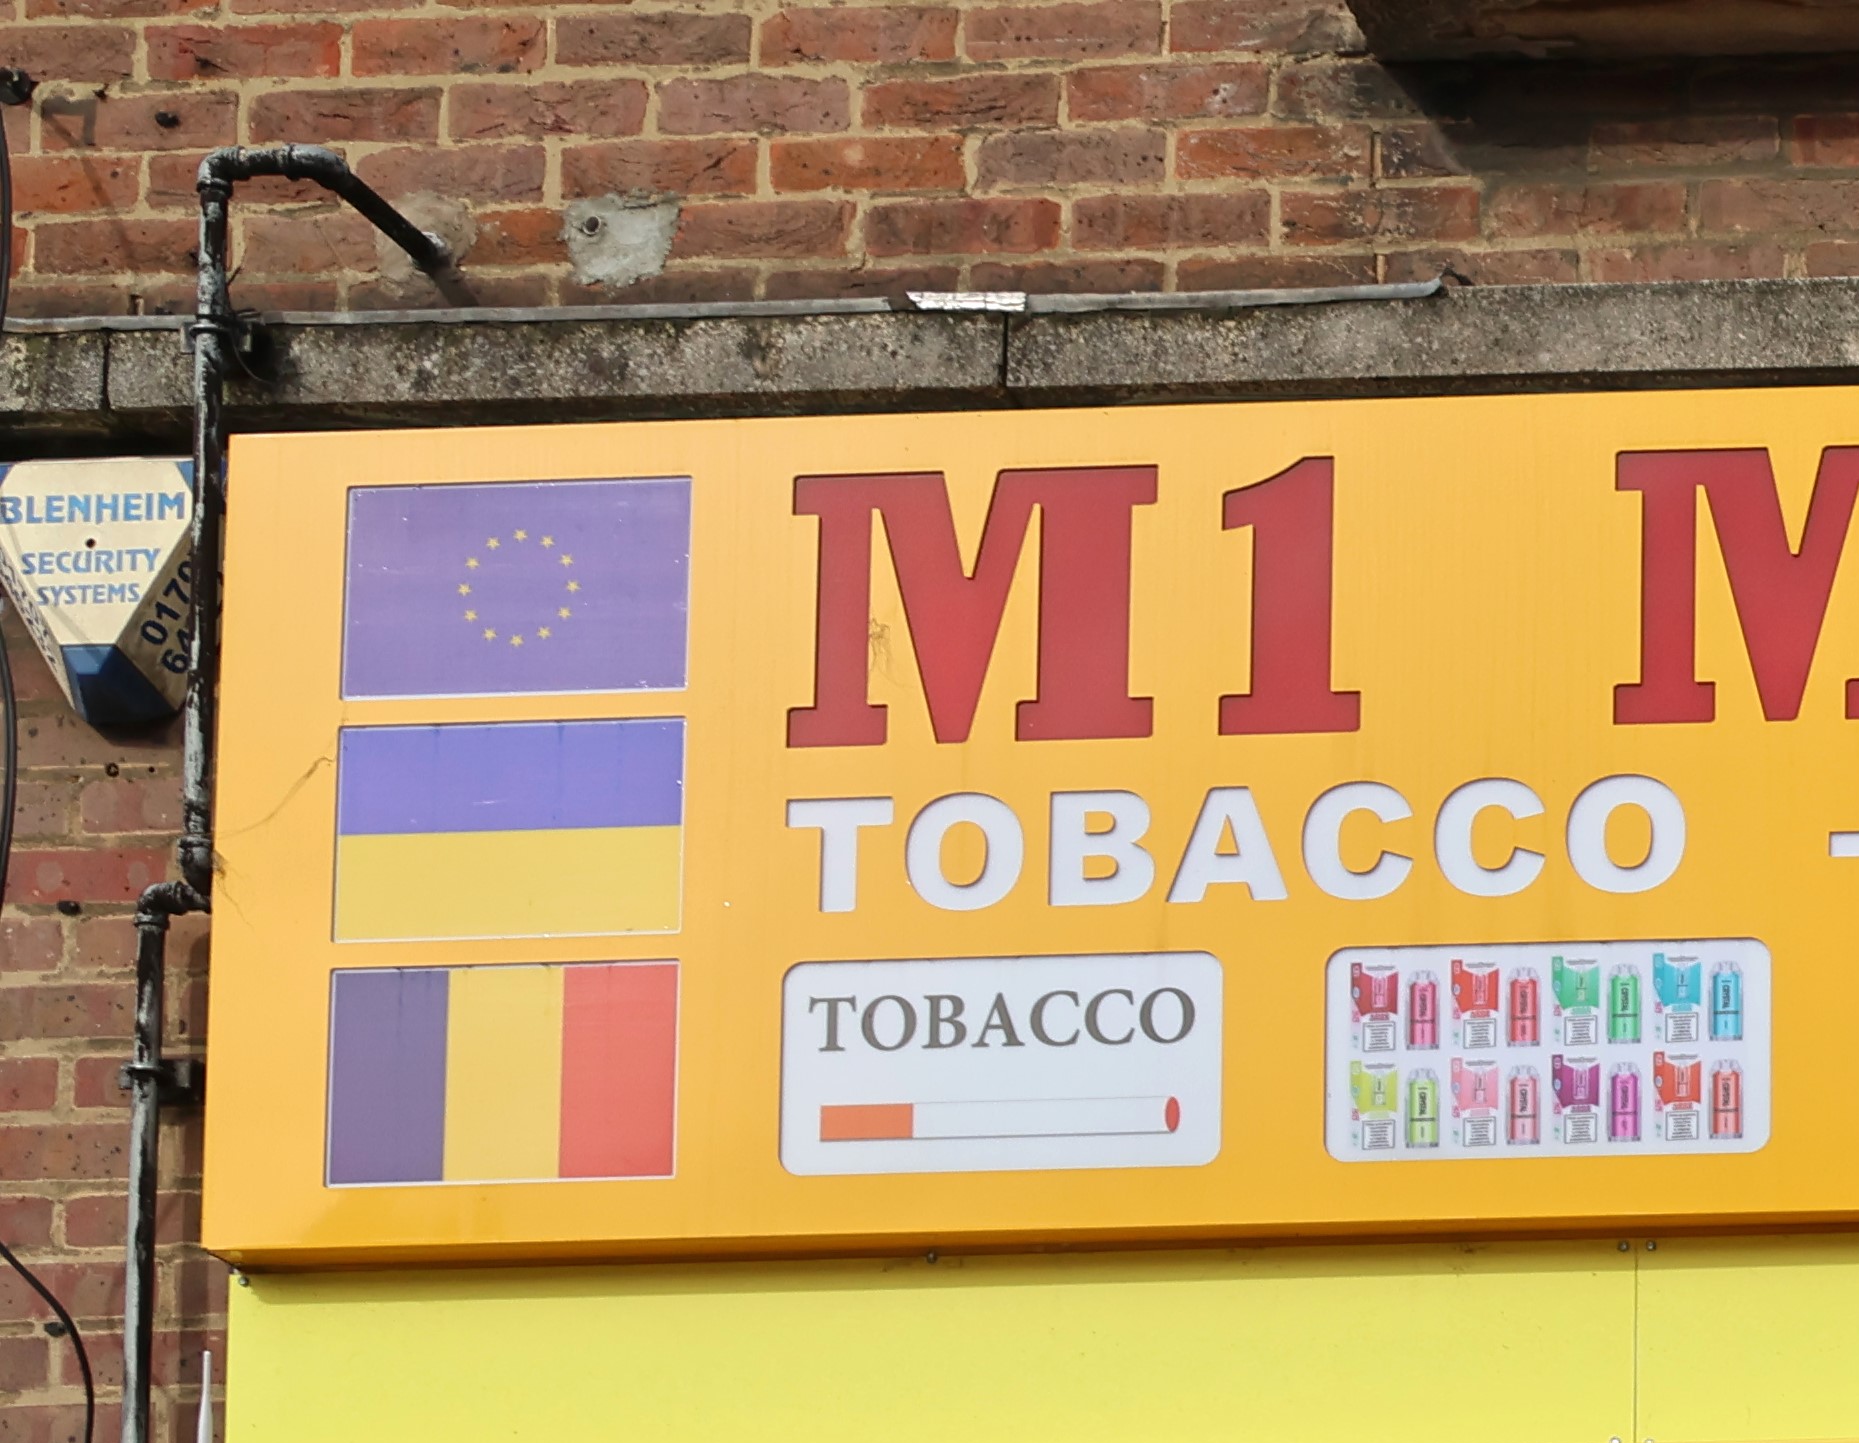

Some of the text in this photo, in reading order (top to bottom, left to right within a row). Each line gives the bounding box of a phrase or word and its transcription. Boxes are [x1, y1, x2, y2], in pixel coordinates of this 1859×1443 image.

[0, 491, 185, 524] BLENHEIM
[22, 548, 160, 575] SECURITY
[37, 583, 140, 607] SYSTEMS
[785, 455, 1361, 748] M1
[787, 773, 1688, 913] TOBACCO
[809, 986, 1196, 1053] TOBACCO
